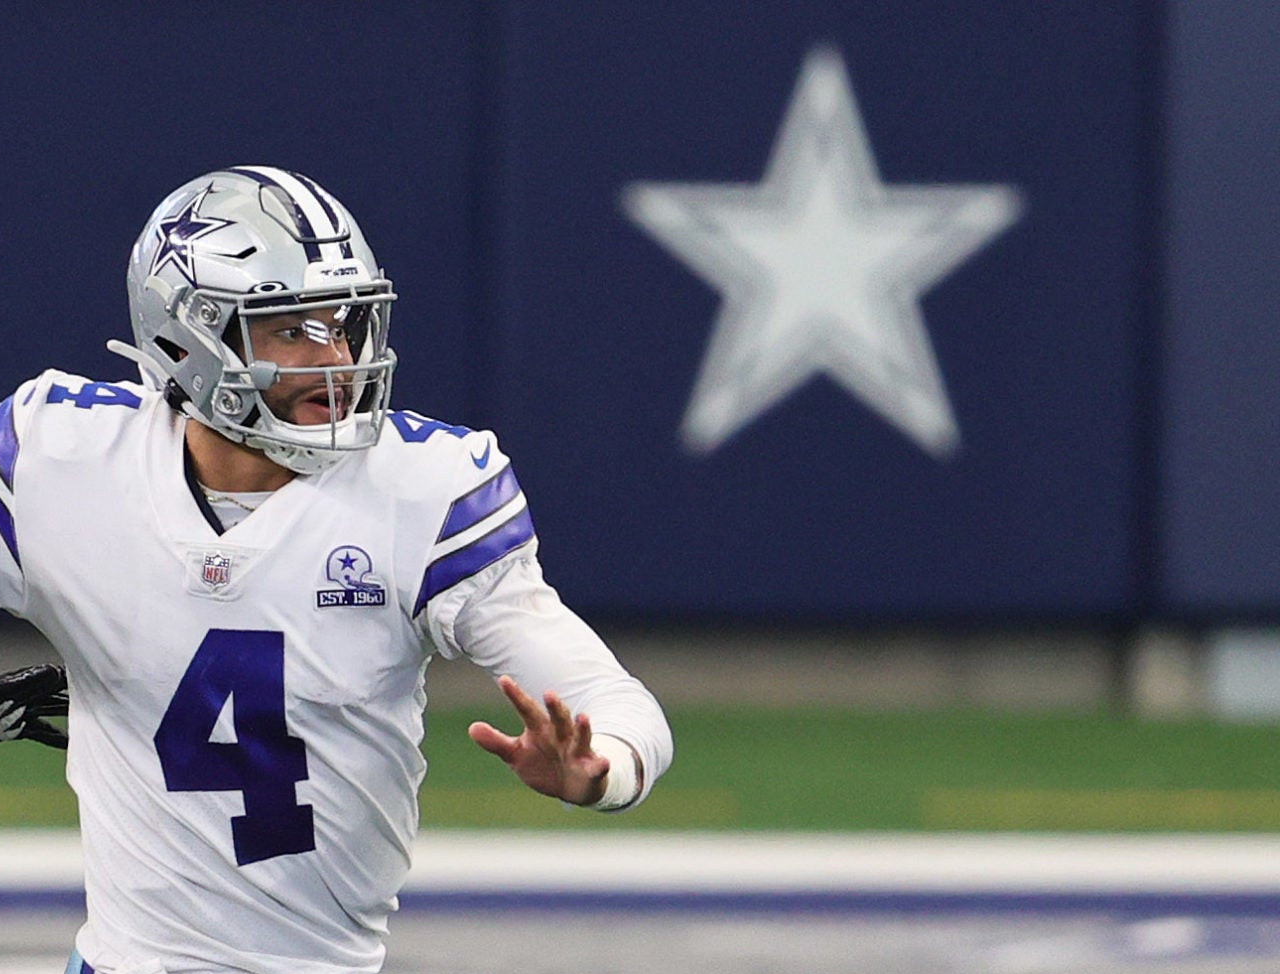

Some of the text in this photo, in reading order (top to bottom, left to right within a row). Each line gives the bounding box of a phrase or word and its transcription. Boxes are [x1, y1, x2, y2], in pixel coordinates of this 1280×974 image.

[46, 382, 143, 410] 4
[320, 591, 384, 606] EST. 1960
[154, 628, 317, 867] 4
